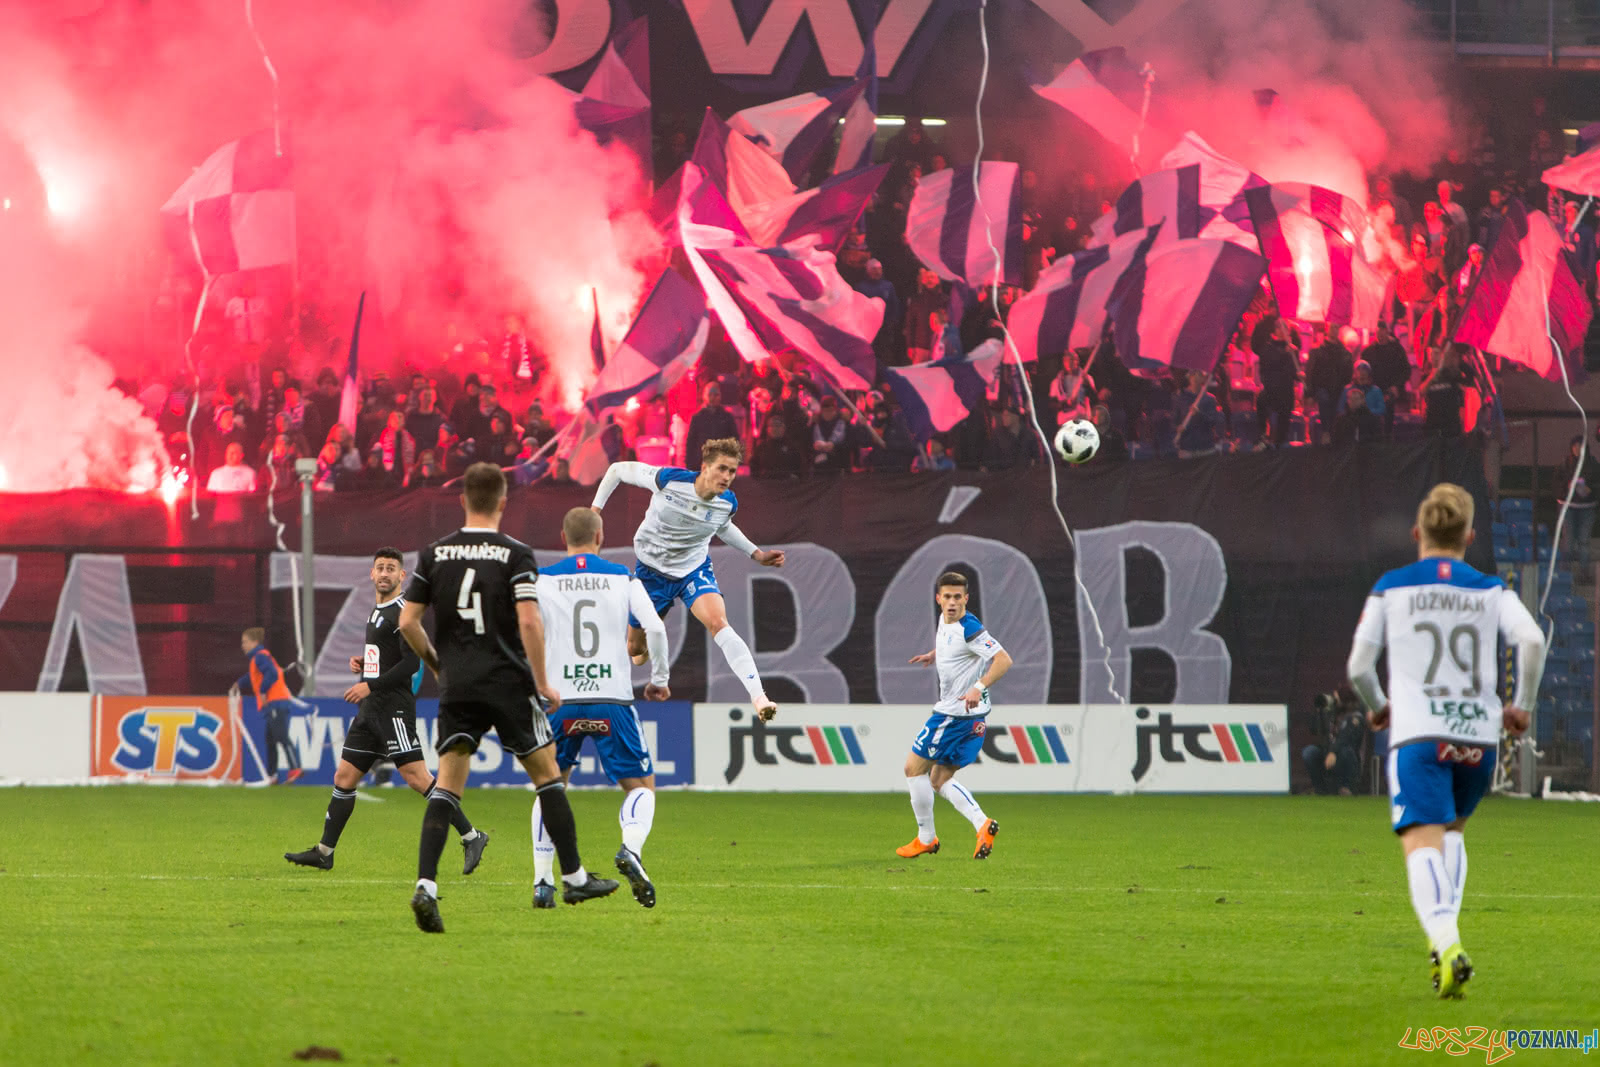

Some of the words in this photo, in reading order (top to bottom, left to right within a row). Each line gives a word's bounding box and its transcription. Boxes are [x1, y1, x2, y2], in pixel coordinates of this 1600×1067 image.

[434, 542, 511, 564] SZYMAŃSKI
[456, 567, 485, 635] 4
[557, 577, 611, 592] TRAŁKA
[573, 599, 599, 659] 6
[563, 663, 612, 679] LECH
[1414, 620, 1482, 697] 29
[1430, 700, 1489, 721] LECH
[111, 706, 222, 775] STS
